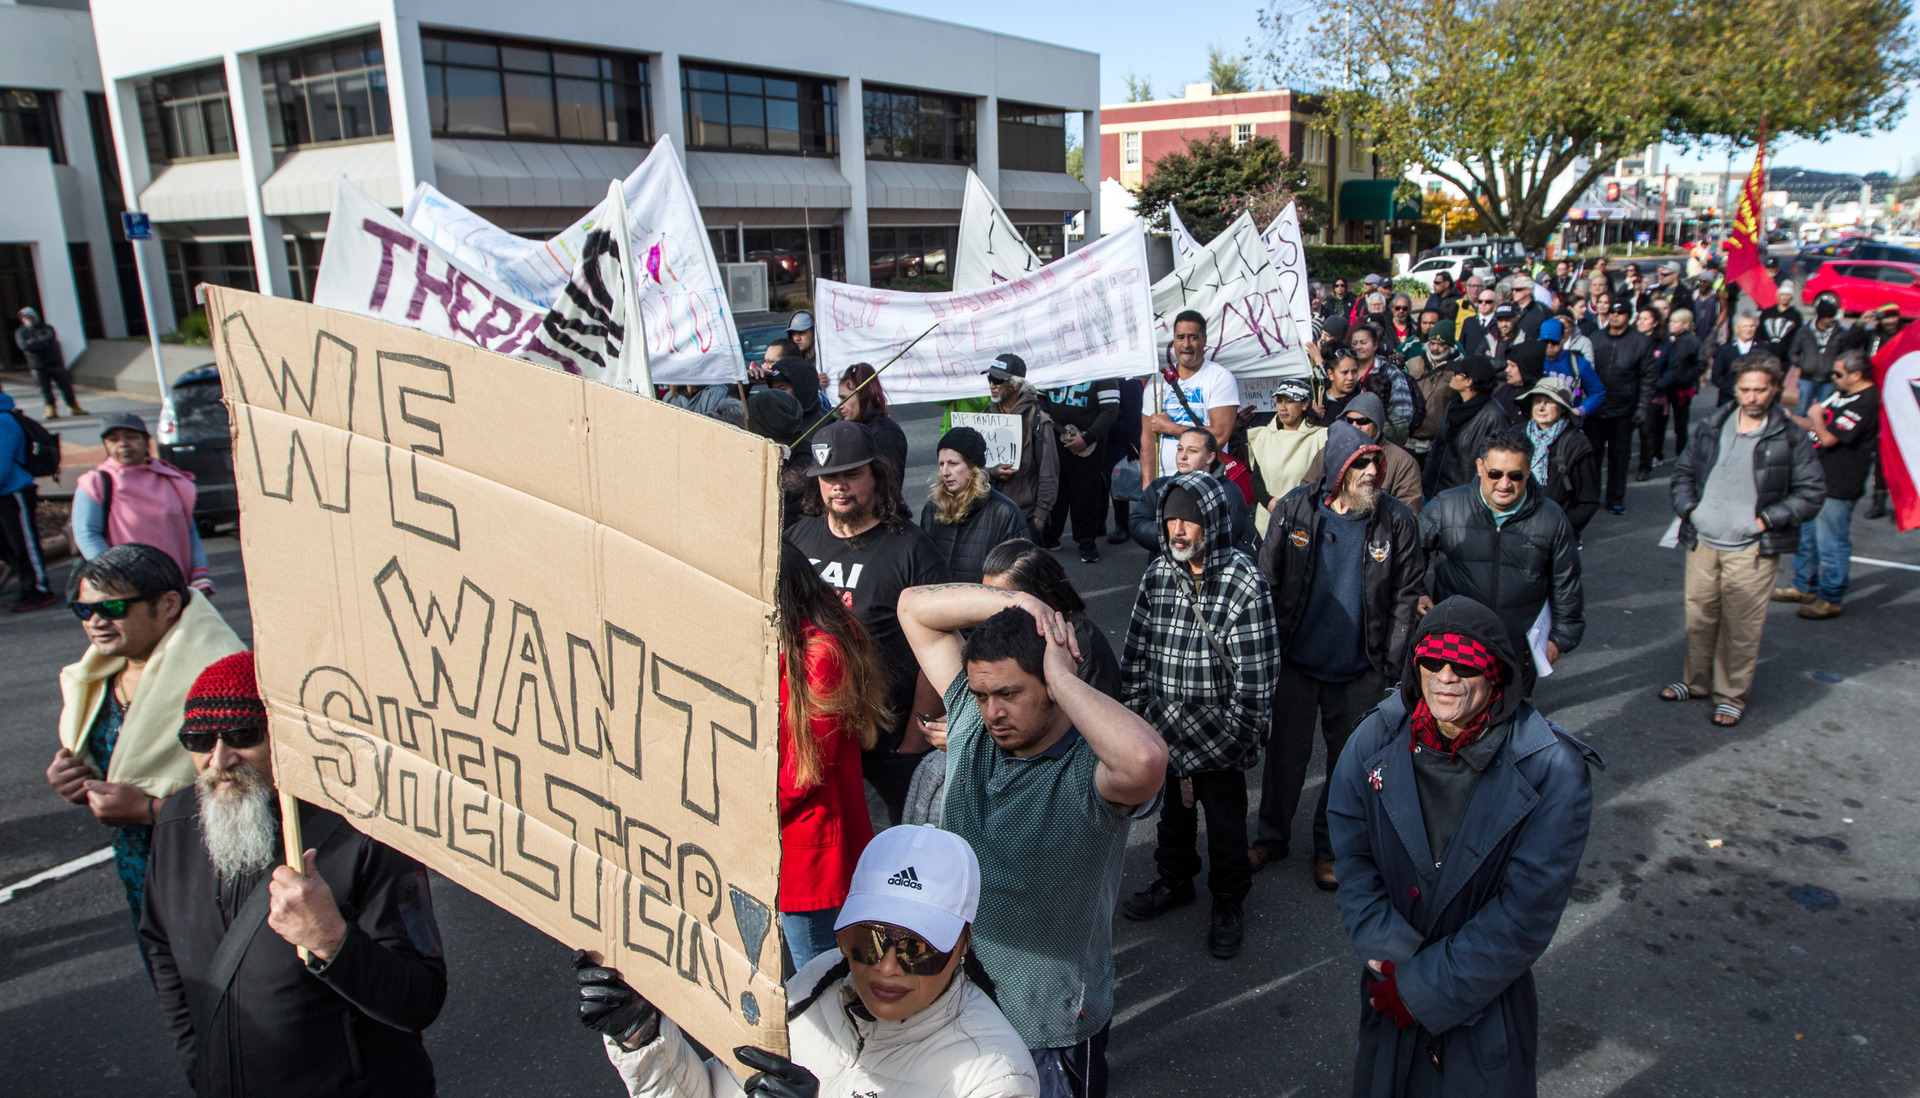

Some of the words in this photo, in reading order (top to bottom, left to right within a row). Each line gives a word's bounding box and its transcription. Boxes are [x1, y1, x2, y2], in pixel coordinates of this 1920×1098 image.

[222, 310, 461, 551] WE
[952, 412, 969, 426] MP
[970, 414, 1015, 428] TAMATI
[808, 558, 864, 589] AI
[373, 555, 757, 826] WANT
[299, 665, 772, 1027] SHELTER!
[887, 876, 923, 891] adidas
